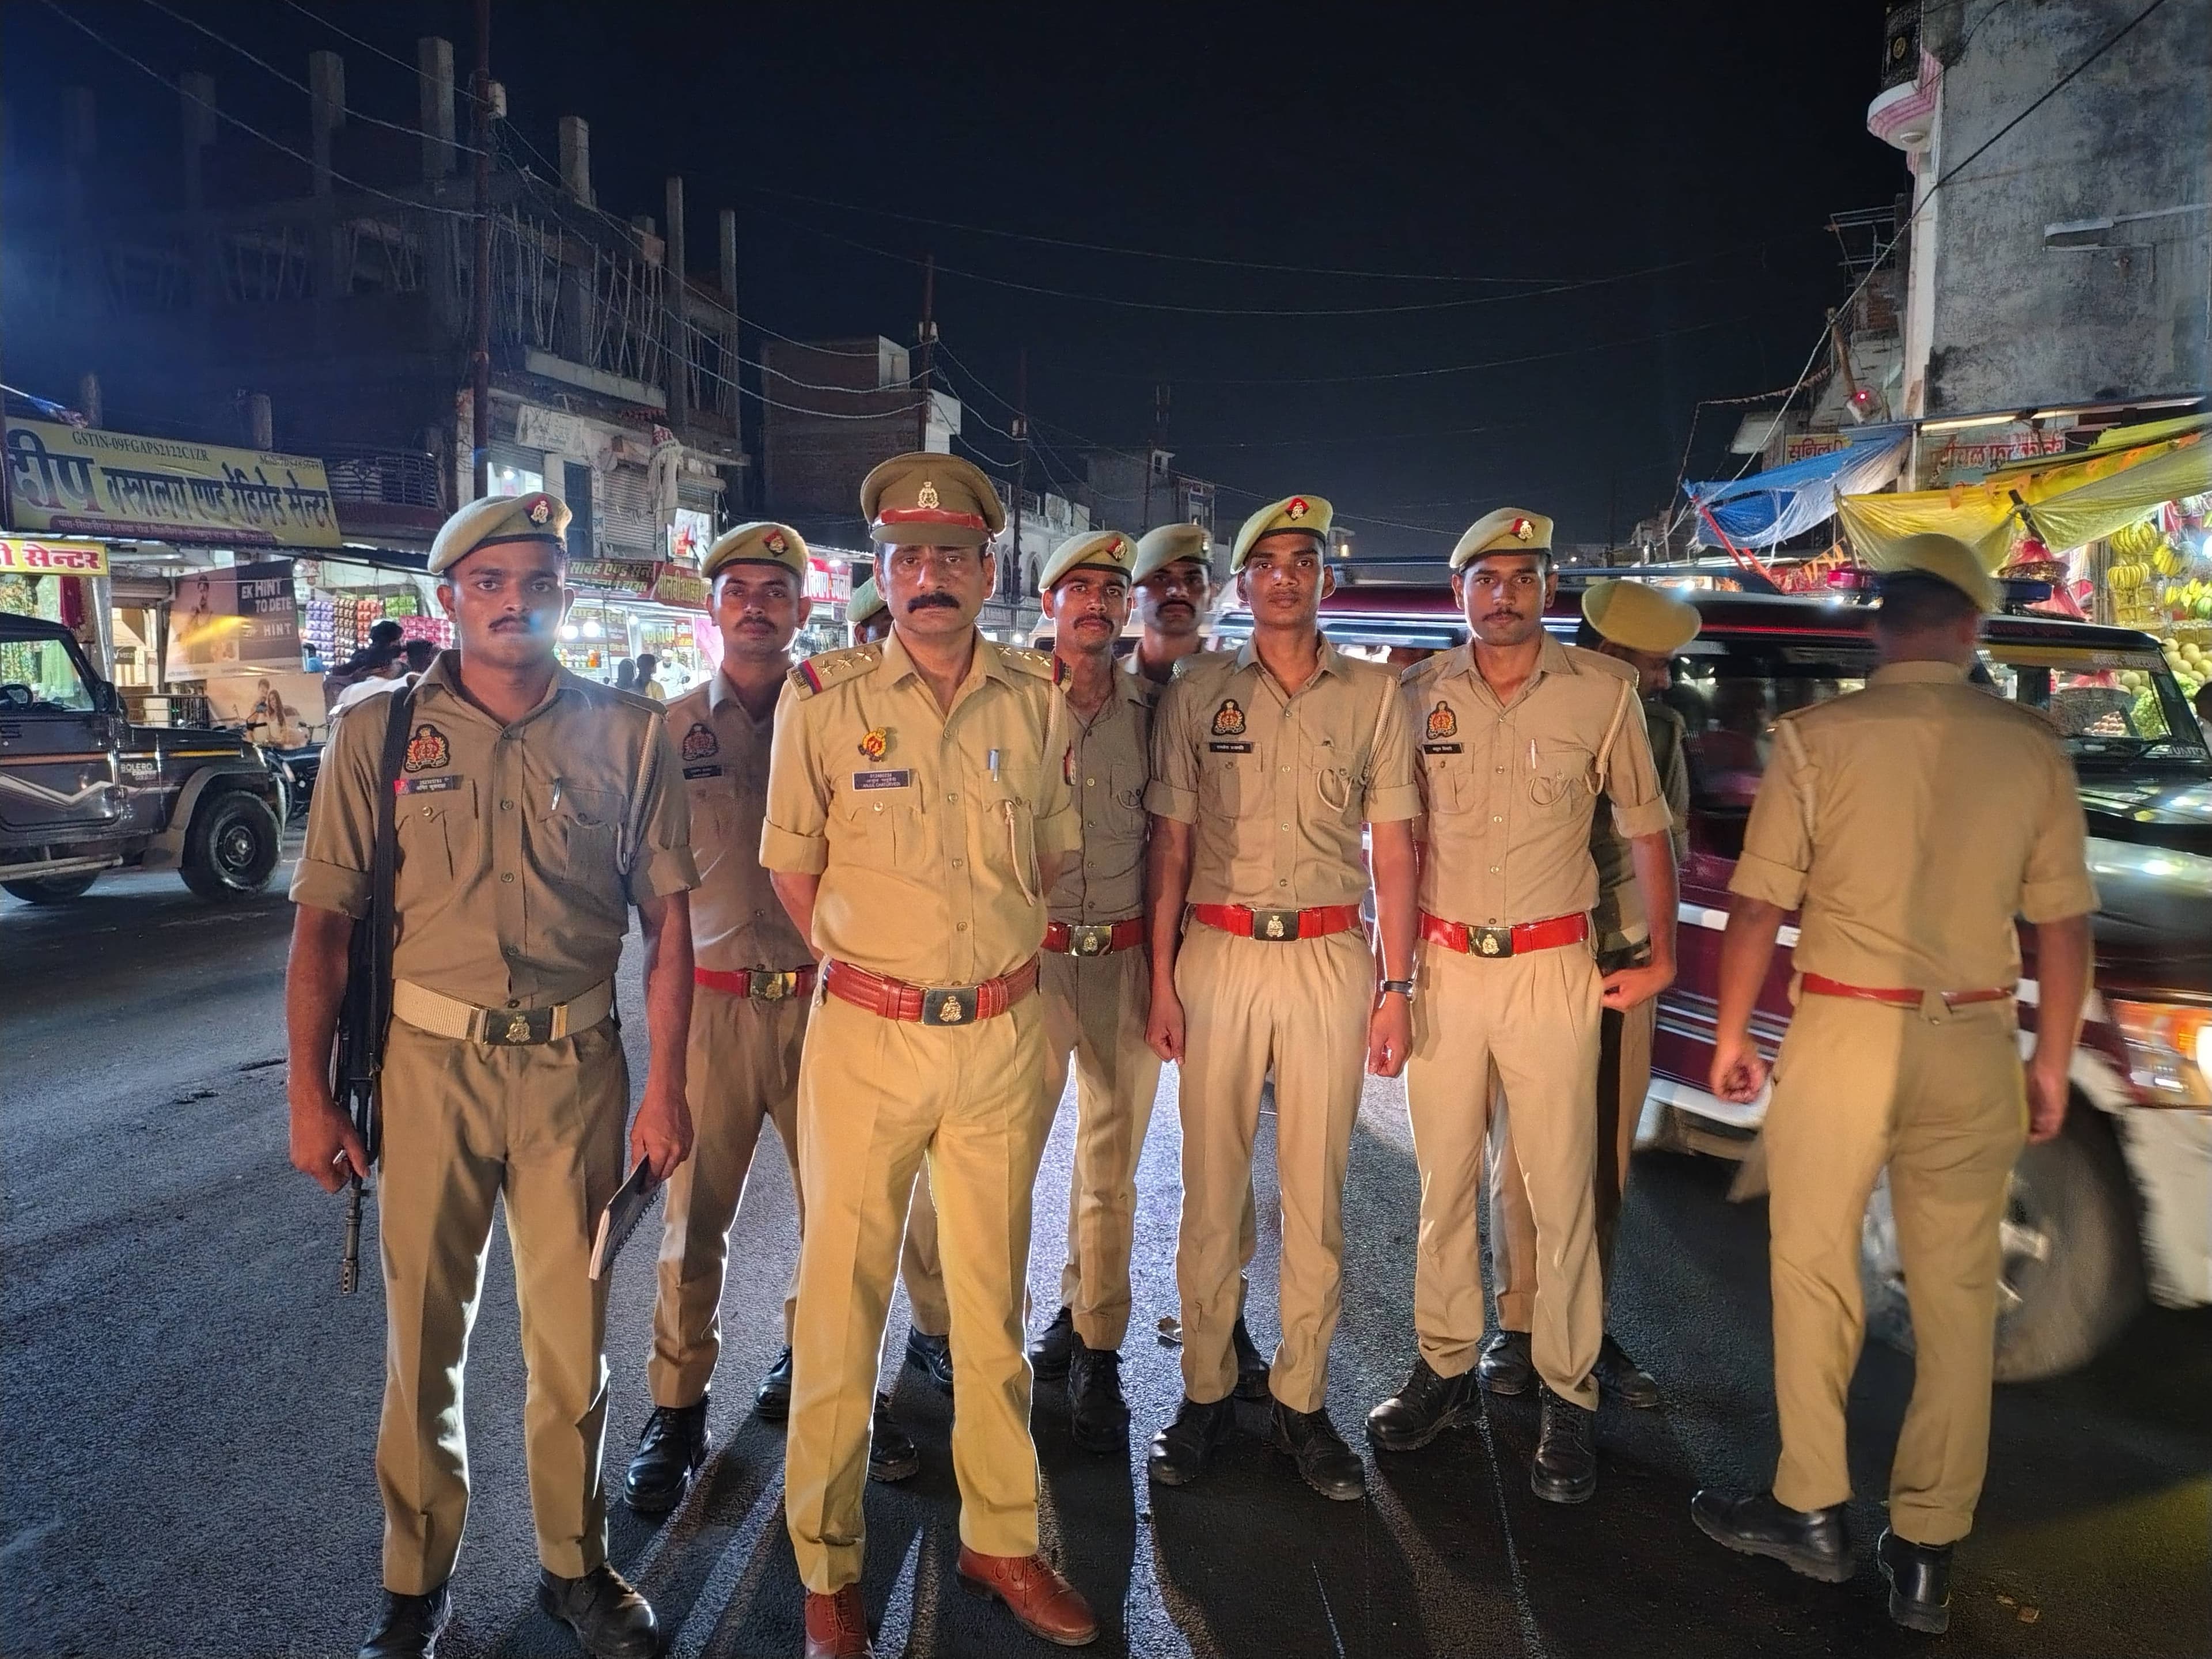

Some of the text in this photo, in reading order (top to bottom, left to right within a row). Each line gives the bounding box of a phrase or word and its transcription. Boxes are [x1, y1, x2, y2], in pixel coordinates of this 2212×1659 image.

[7, 429, 105, 513] दीप
[22, 544, 100, 569] सेन्टर
[241, 578, 281, 599] EK HINT
[255, 599, 268, 613] TO
[263, 623, 291, 636] HINT
[120, 763, 153, 772] BOLERO
